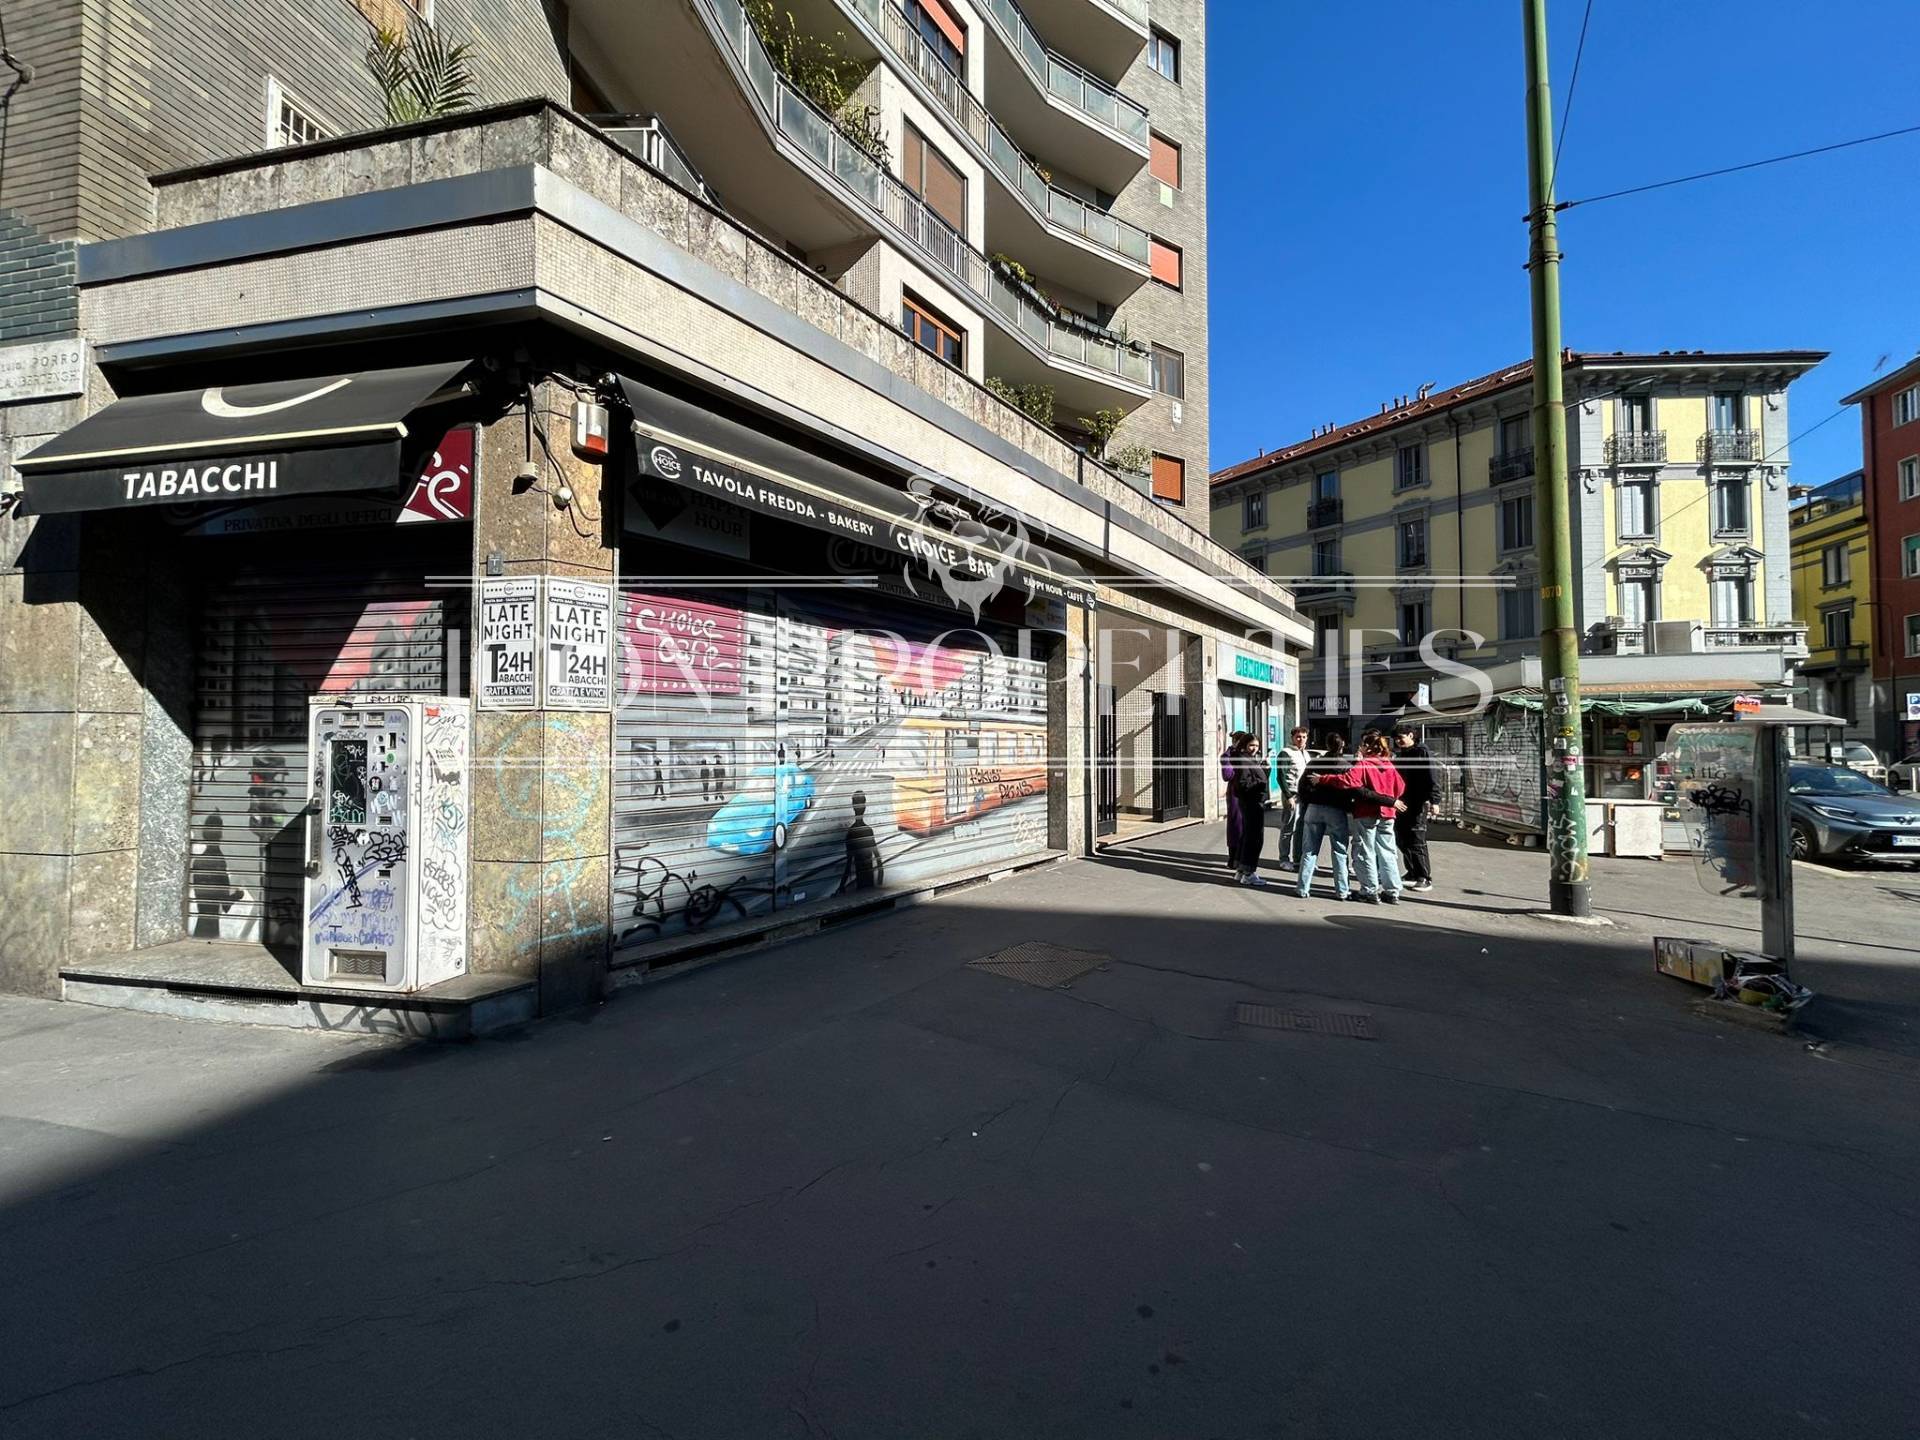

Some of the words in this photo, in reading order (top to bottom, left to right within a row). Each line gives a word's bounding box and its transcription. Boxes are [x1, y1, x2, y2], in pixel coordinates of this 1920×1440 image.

[123, 461, 277, 500] TABACCHI
[692, 465, 755, 500] TAVOLA
[759, 489, 816, 519] FREDDA
[828, 511, 874, 537] BAKERY
[896, 532, 958, 566] CHOICE
[967, 556, 995, 579] BAR
[488, 604, 529, 622] LATE
[556, 604, 602, 627] LATE
[484, 623, 533, 641] NIGHT
[550, 623, 607, 645] NIGHT
[499, 651, 533, 672] 24H
[568, 653, 607, 676] 24H
[484, 686, 509, 697] GRATTA
[550, 686, 579, 697] GRATTA
[1308, 696, 1348, 711] MICAMERA
